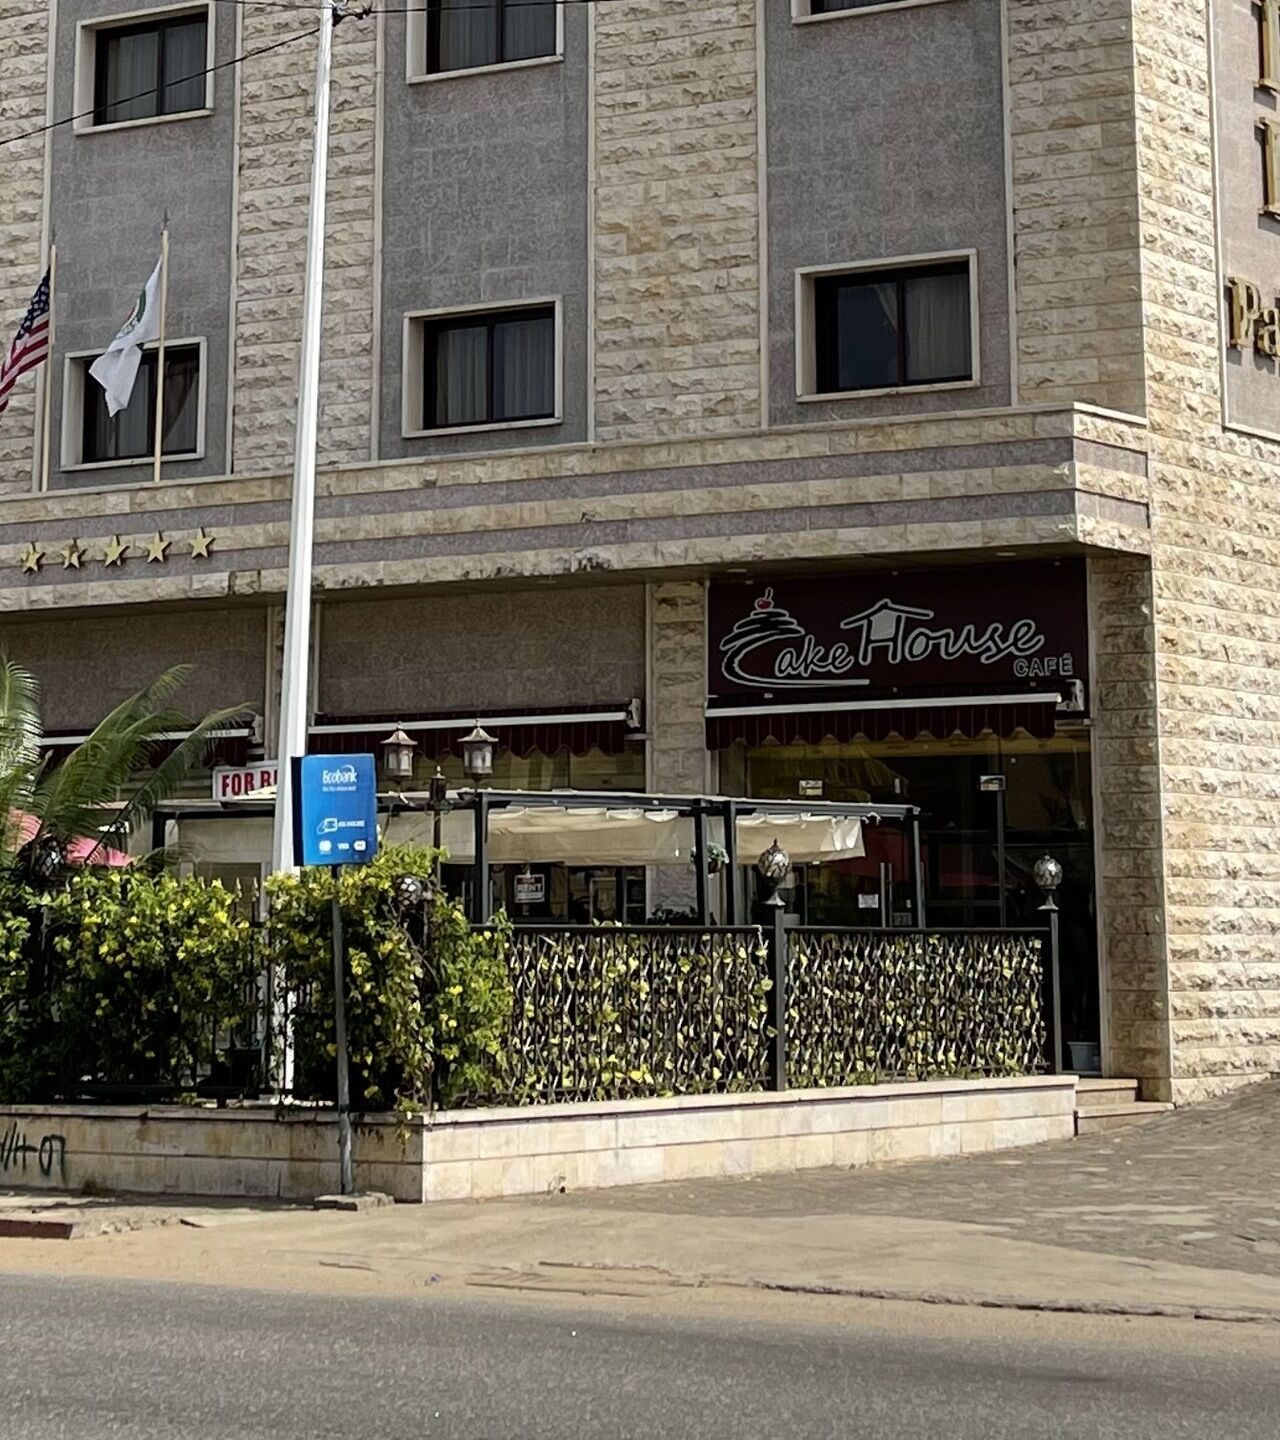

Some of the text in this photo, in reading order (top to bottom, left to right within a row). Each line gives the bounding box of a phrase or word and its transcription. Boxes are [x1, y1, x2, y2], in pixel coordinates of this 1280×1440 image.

[720, 599, 1046, 688] Cake House
[1012, 653, 1074, 677] CAFÉ
[222, 772, 255, 796] FOR
[322, 765, 358, 785] Ecobank
